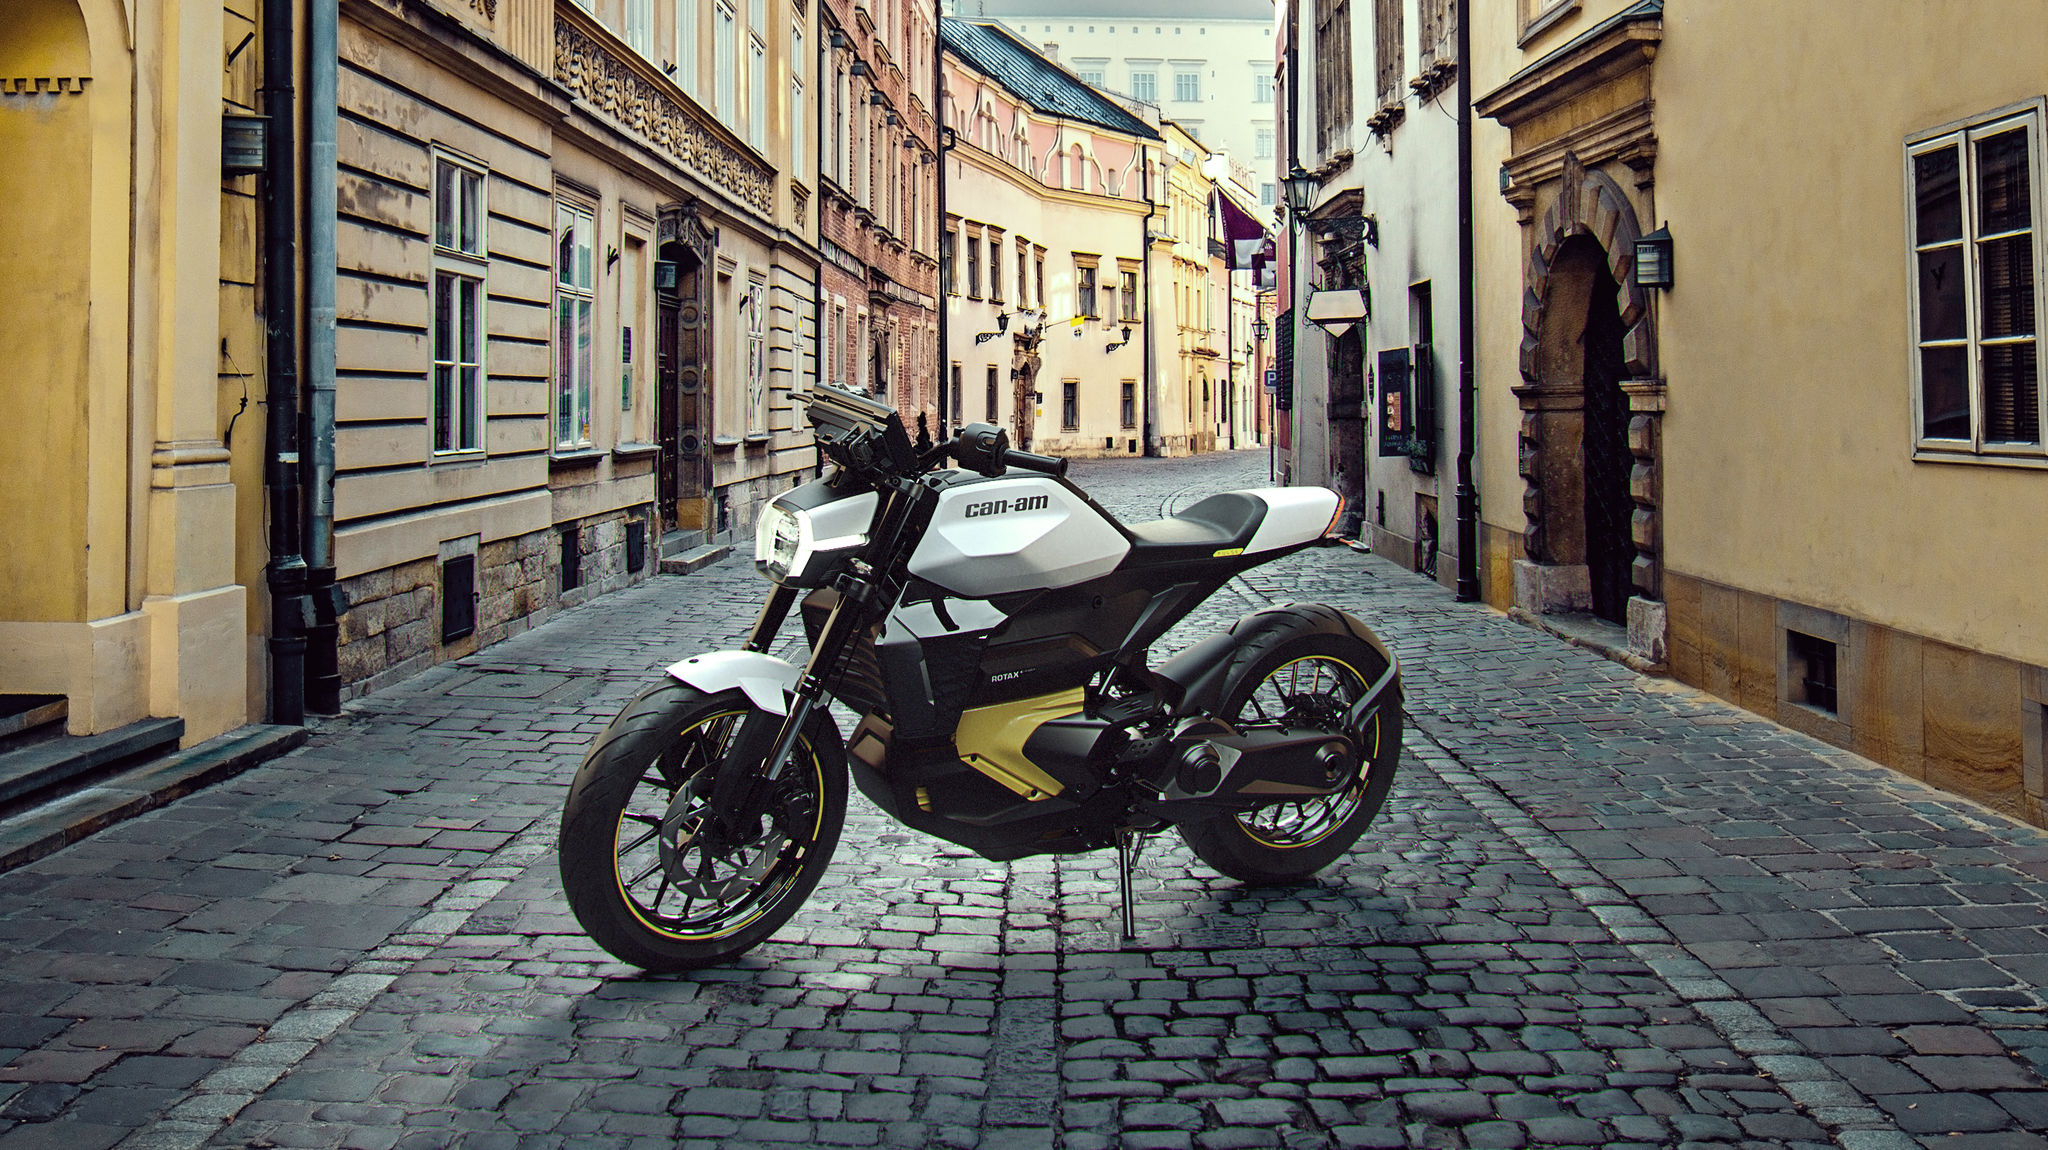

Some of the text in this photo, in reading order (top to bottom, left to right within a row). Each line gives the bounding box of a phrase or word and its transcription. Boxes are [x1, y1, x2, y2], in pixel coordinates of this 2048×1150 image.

[1267, 372, 1277, 385] P
[965, 495, 1049, 518] can-am
[991, 670, 1019, 683] ROTAX
